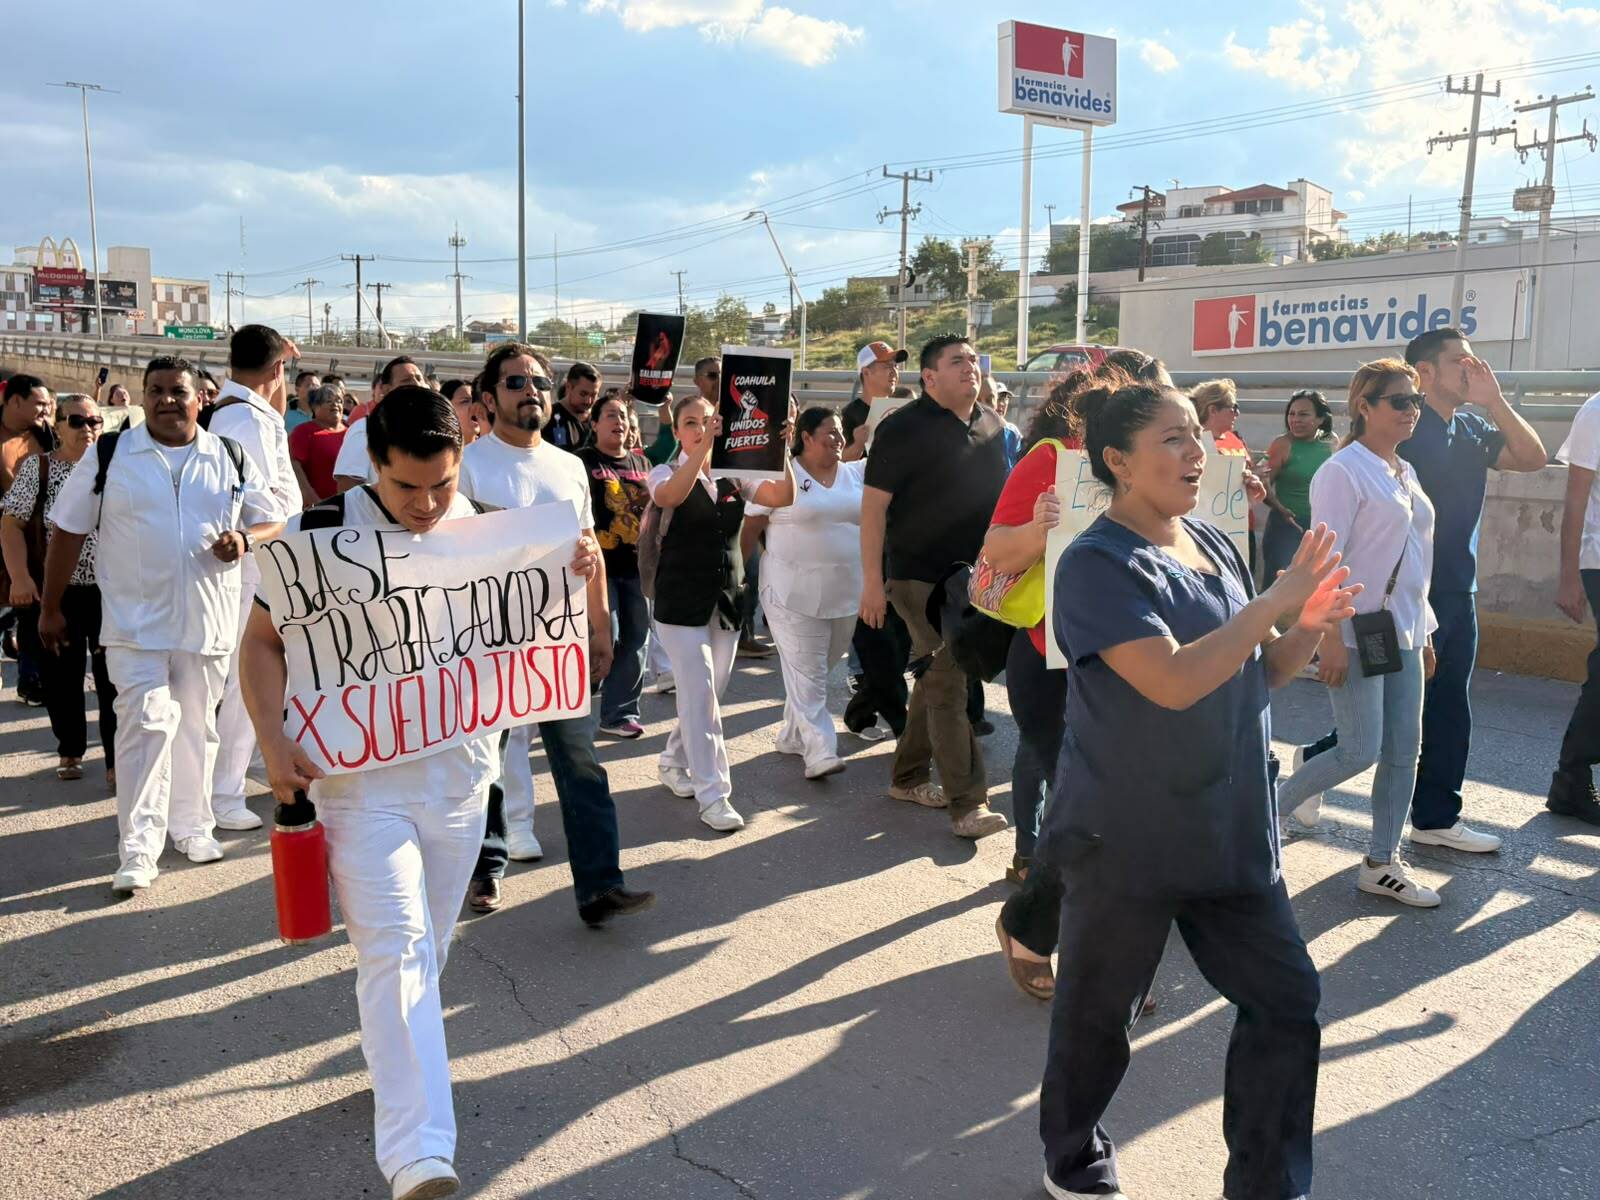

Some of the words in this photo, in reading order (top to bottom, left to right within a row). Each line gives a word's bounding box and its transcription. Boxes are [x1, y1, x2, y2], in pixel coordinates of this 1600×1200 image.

[1020, 75, 1067, 92] farmacias
[1015, 78, 1112, 114] benavides
[1272, 294, 1369, 317] farmacias
[1259, 294, 1478, 347] benavides
[735, 375, 776, 386] COAHUILA
[730, 419, 766, 432] UNIDOS
[724, 433, 769, 450] FUERTES
[260, 528, 419, 620] BASE
[290, 694, 338, 769] X
[338, 657, 478, 769] SUELDO
[482, 643, 586, 726] JUSTO
